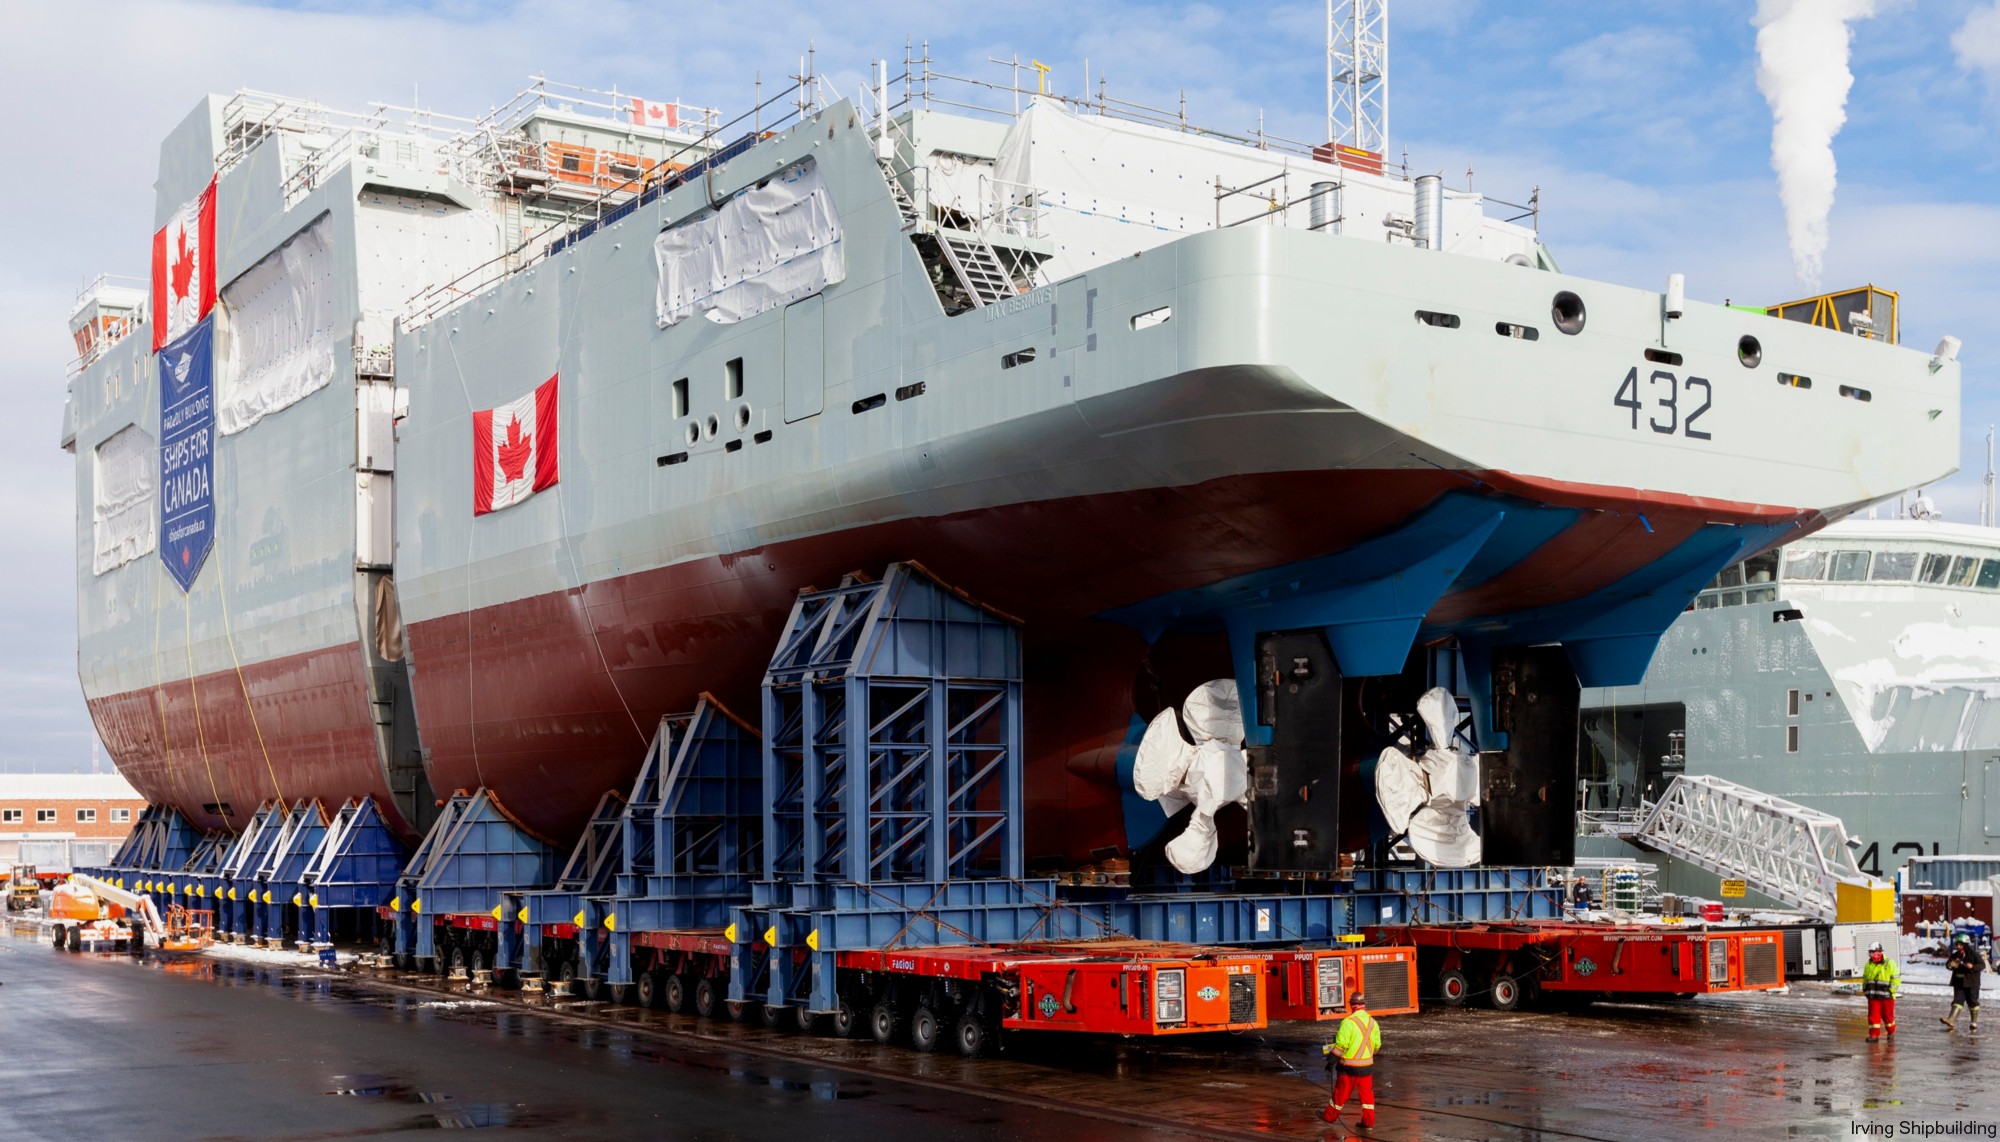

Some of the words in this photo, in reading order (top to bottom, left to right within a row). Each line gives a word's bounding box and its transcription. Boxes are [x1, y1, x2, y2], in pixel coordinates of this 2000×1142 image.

[985, 303, 1006, 323] MAX
[1008, 287, 1051, 315] BERNAYS
[163, 411, 184, 431] PROUDLY
[184, 395, 209, 420] BUILDING
[1614, 366, 1711, 440] 432
[164, 439, 189, 474] SHIPS
[190, 428, 209, 462] FOR
[164, 462, 210, 514] CANADA
[169, 519, 205, 543] shipsforcanada.ca
[1294, 953, 1313, 961] PPU03
[1574, 963, 1597, 971] IRVING
[1039, 1002, 1060, 1010] IRVING
